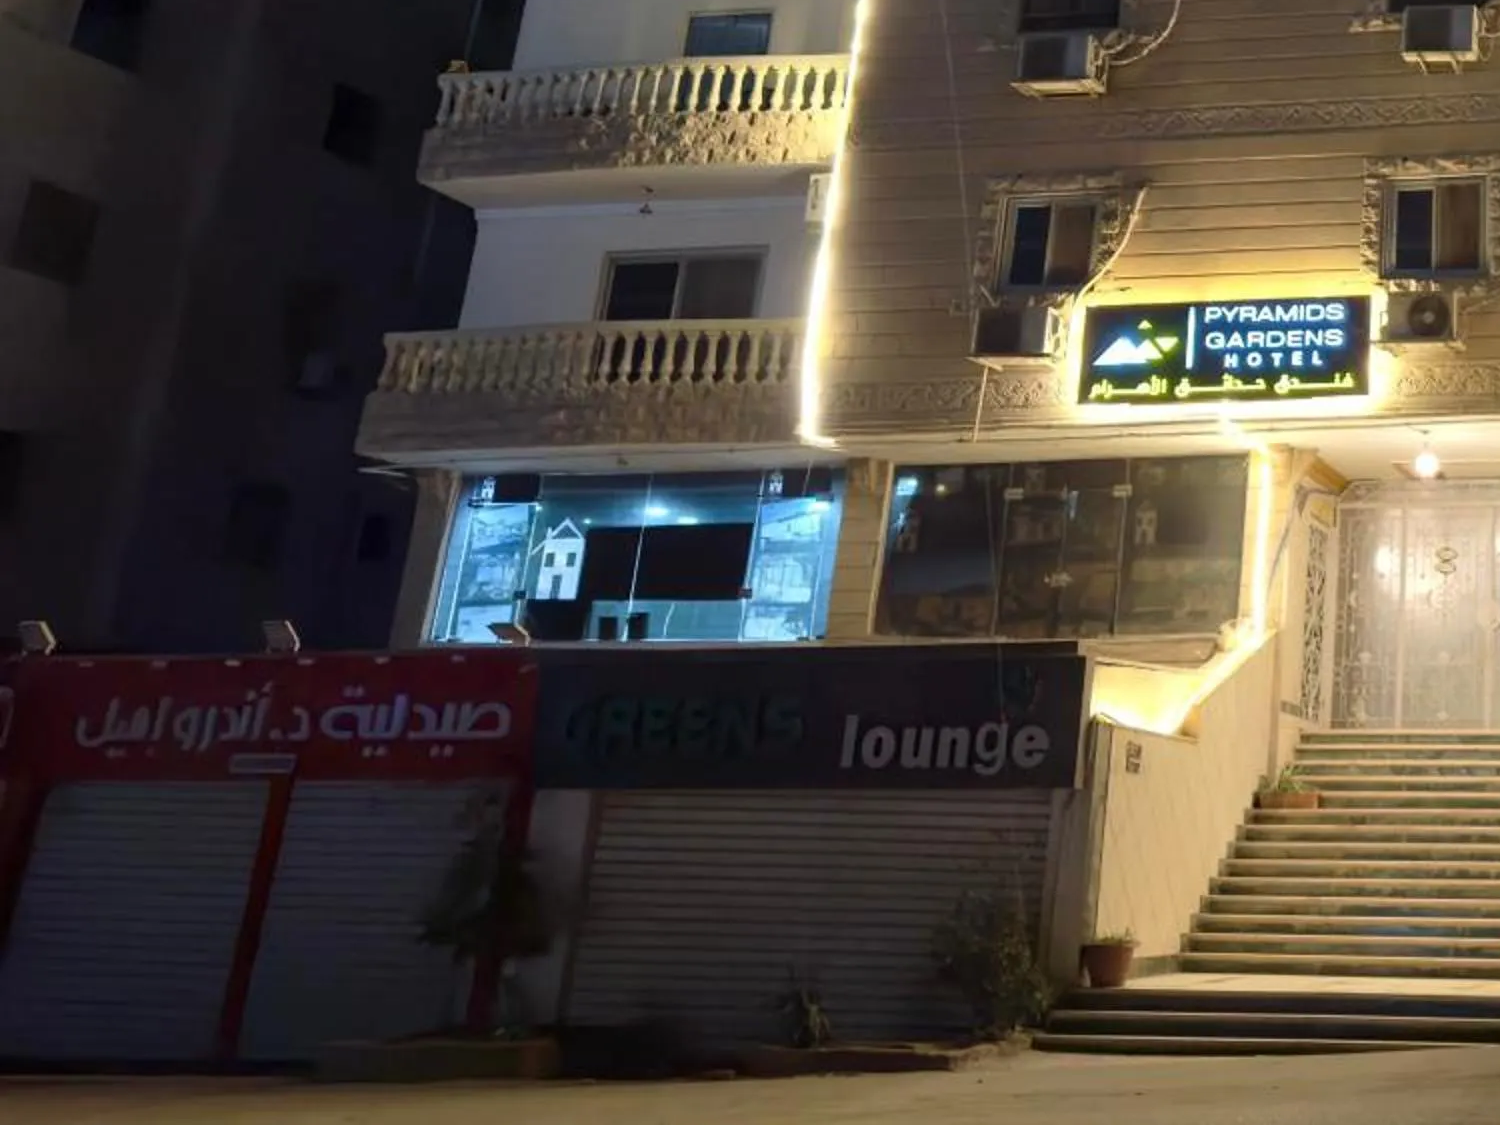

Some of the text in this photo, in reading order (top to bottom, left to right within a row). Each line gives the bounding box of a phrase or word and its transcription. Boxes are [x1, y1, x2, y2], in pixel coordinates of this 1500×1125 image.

[1204, 303, 1346, 324] PYRAMIDS
[1204, 329, 1345, 350] GARDENS
[1223, 351, 1325, 369] HOTEL
[319, 685, 513, 758] صيدلية
[839, 713, 1051, 775] lounge
